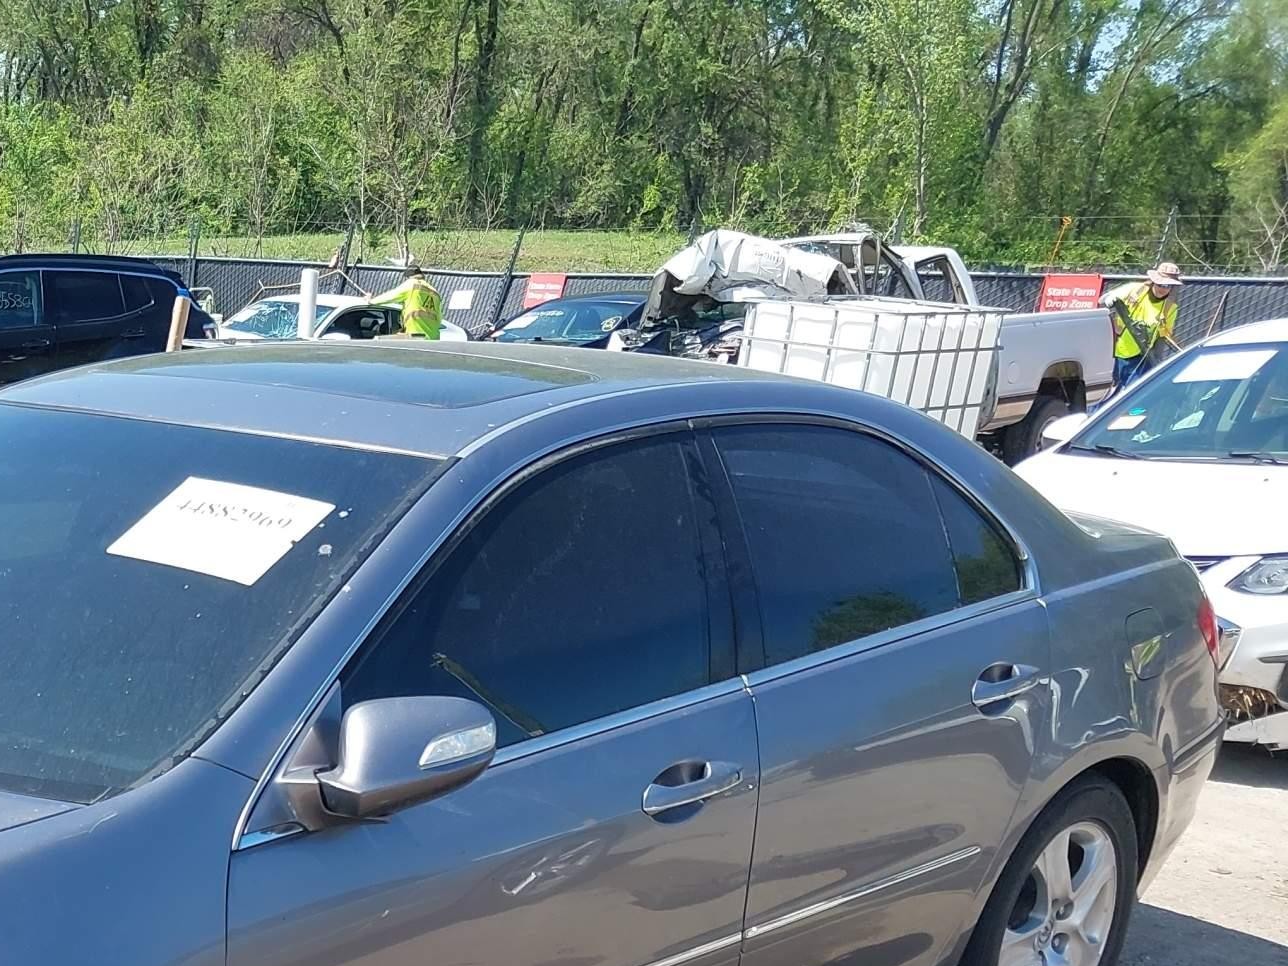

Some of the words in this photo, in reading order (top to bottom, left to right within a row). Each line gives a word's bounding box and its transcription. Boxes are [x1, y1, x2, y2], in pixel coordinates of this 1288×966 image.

[1046, 287, 1071, 297] State
[1072, 287, 1097, 297] Farm
[1045, 300, 1068, 309] Drop
[1069, 300, 1094, 308] Zone
